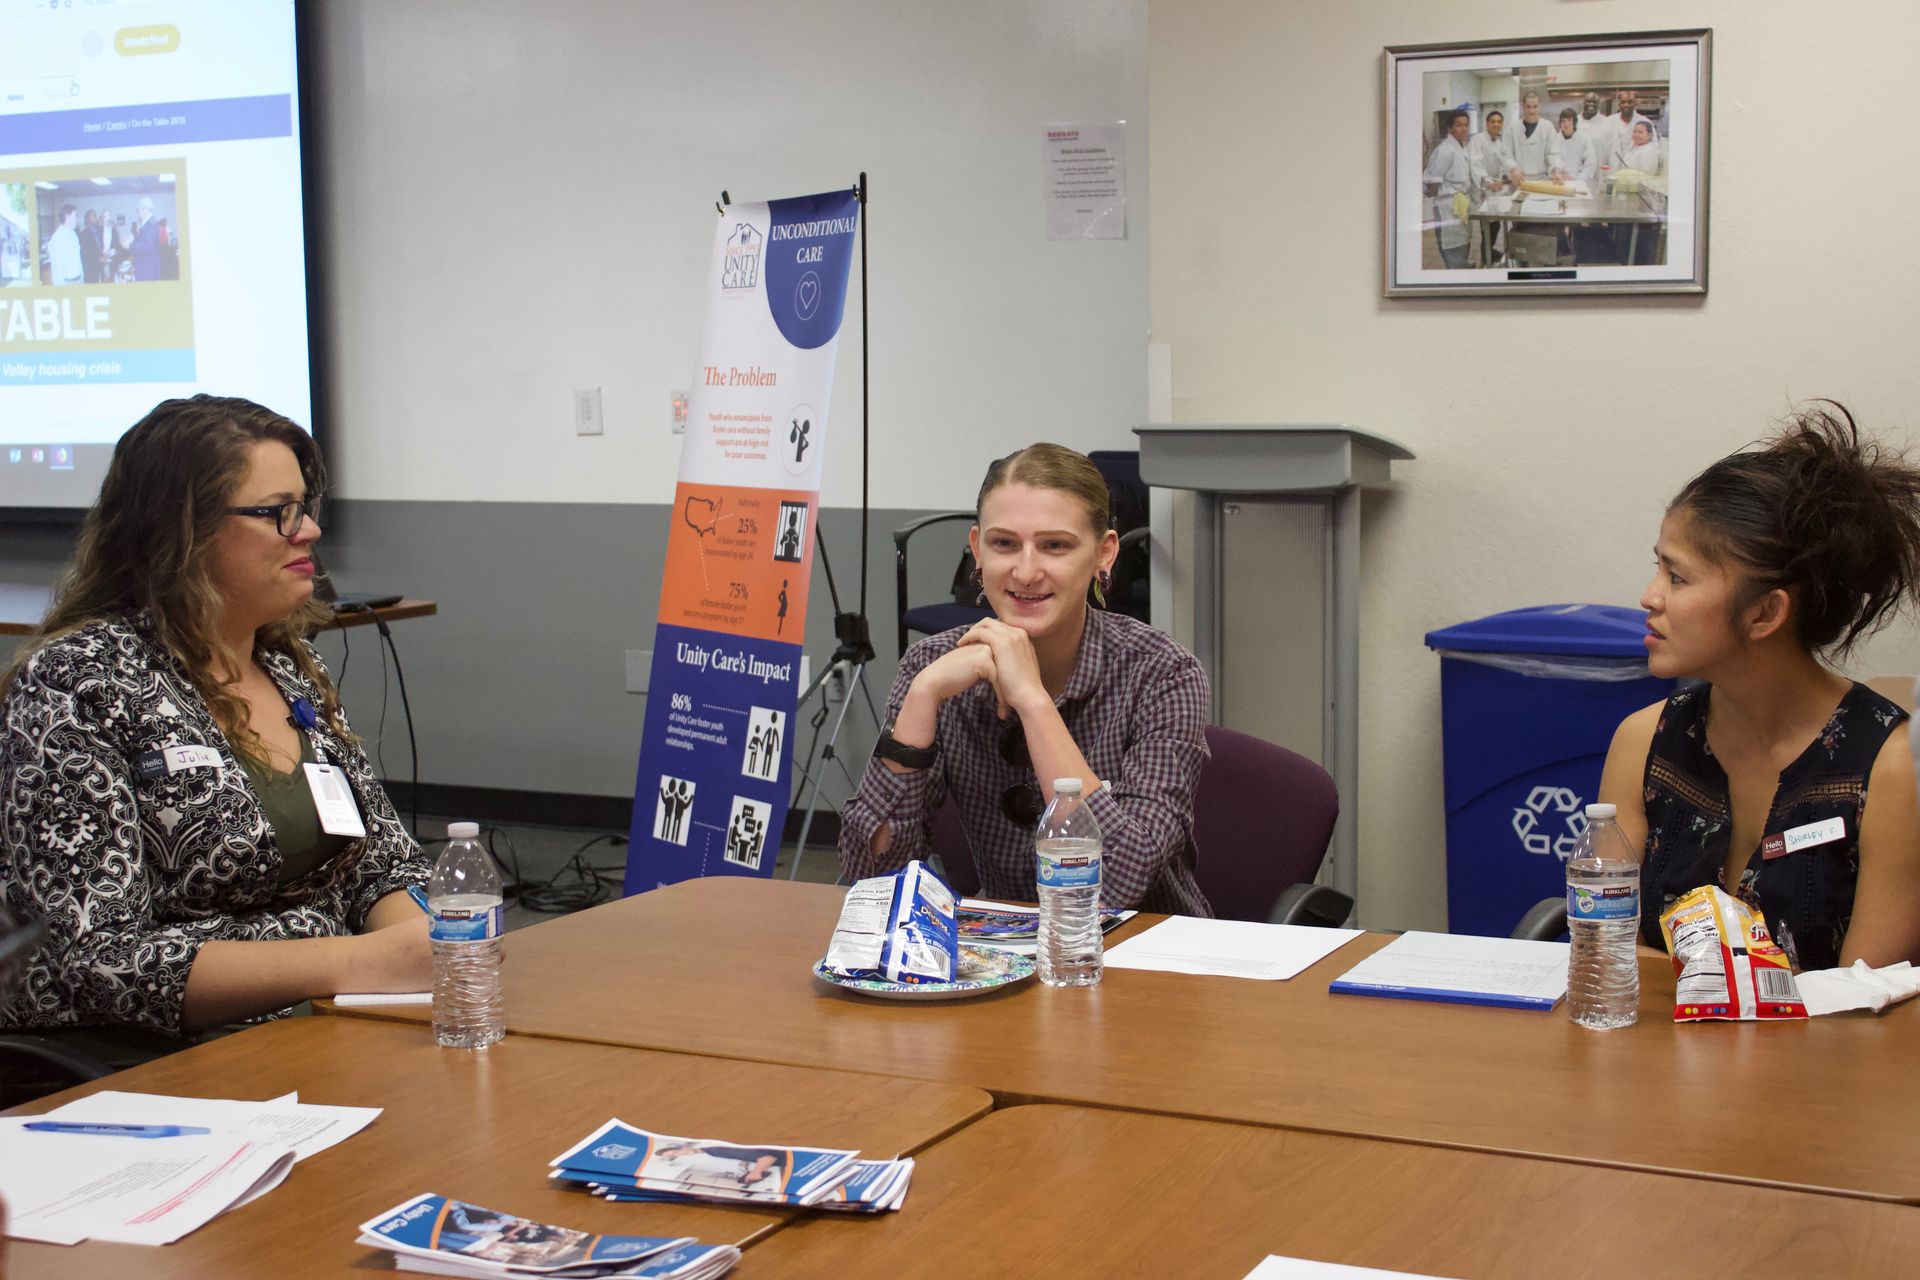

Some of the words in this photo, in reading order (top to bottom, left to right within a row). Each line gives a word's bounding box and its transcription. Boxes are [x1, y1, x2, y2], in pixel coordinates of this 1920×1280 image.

[107, 120, 127, 132] Events
[132, 119, 142, 128] On
[142, 118, 152, 127] the
[153, 117, 170, 127] Table
[772, 216, 856, 241] UNCONDITIONAL
[724, 254, 759, 272] UNITY
[796, 246, 824, 264] CARE
[722, 270, 756, 288] CARE
[2, 364, 36, 379] Valley
[39, 362, 87, 379] housing
[89, 360, 121, 375] crisis
[704, 366, 727, 387] The
[728, 366, 777, 387] Problem
[708, 413, 722, 421] Youth
[734, 415, 760, 423] emancipate
[713, 425, 727, 433] foster
[737, 426, 756, 434] without
[756, 426, 771, 436] family
[716, 439, 734, 447] support
[749, 439, 769, 448] high-risk
[737, 518, 758, 535] 25%
[729, 582, 749, 600] 75%
[734, 603, 747, 612] youth
[676, 642, 710, 672] Unity
[747, 654, 791, 684] Impact
[671, 693, 692, 712] 86%
[669, 713, 675, 721] of
[675, 713, 688, 724] Unity
[687, 716, 698, 725] Care
[698, 717, 710, 728] foster
[710, 720, 724, 731] youth
[667, 725, 692, 737] developed
[691, 728, 716, 742] permanent
[716, 734, 728, 745] adult
[142, 757, 163, 769] Hello
[177, 750, 209, 763] Julie
[1765, 840, 1783, 850] Hello
[1788, 831, 1823, 845] SHIRLEY
[401, 1204, 435, 1222] Unity
[379, 1218, 408, 1235] Care
